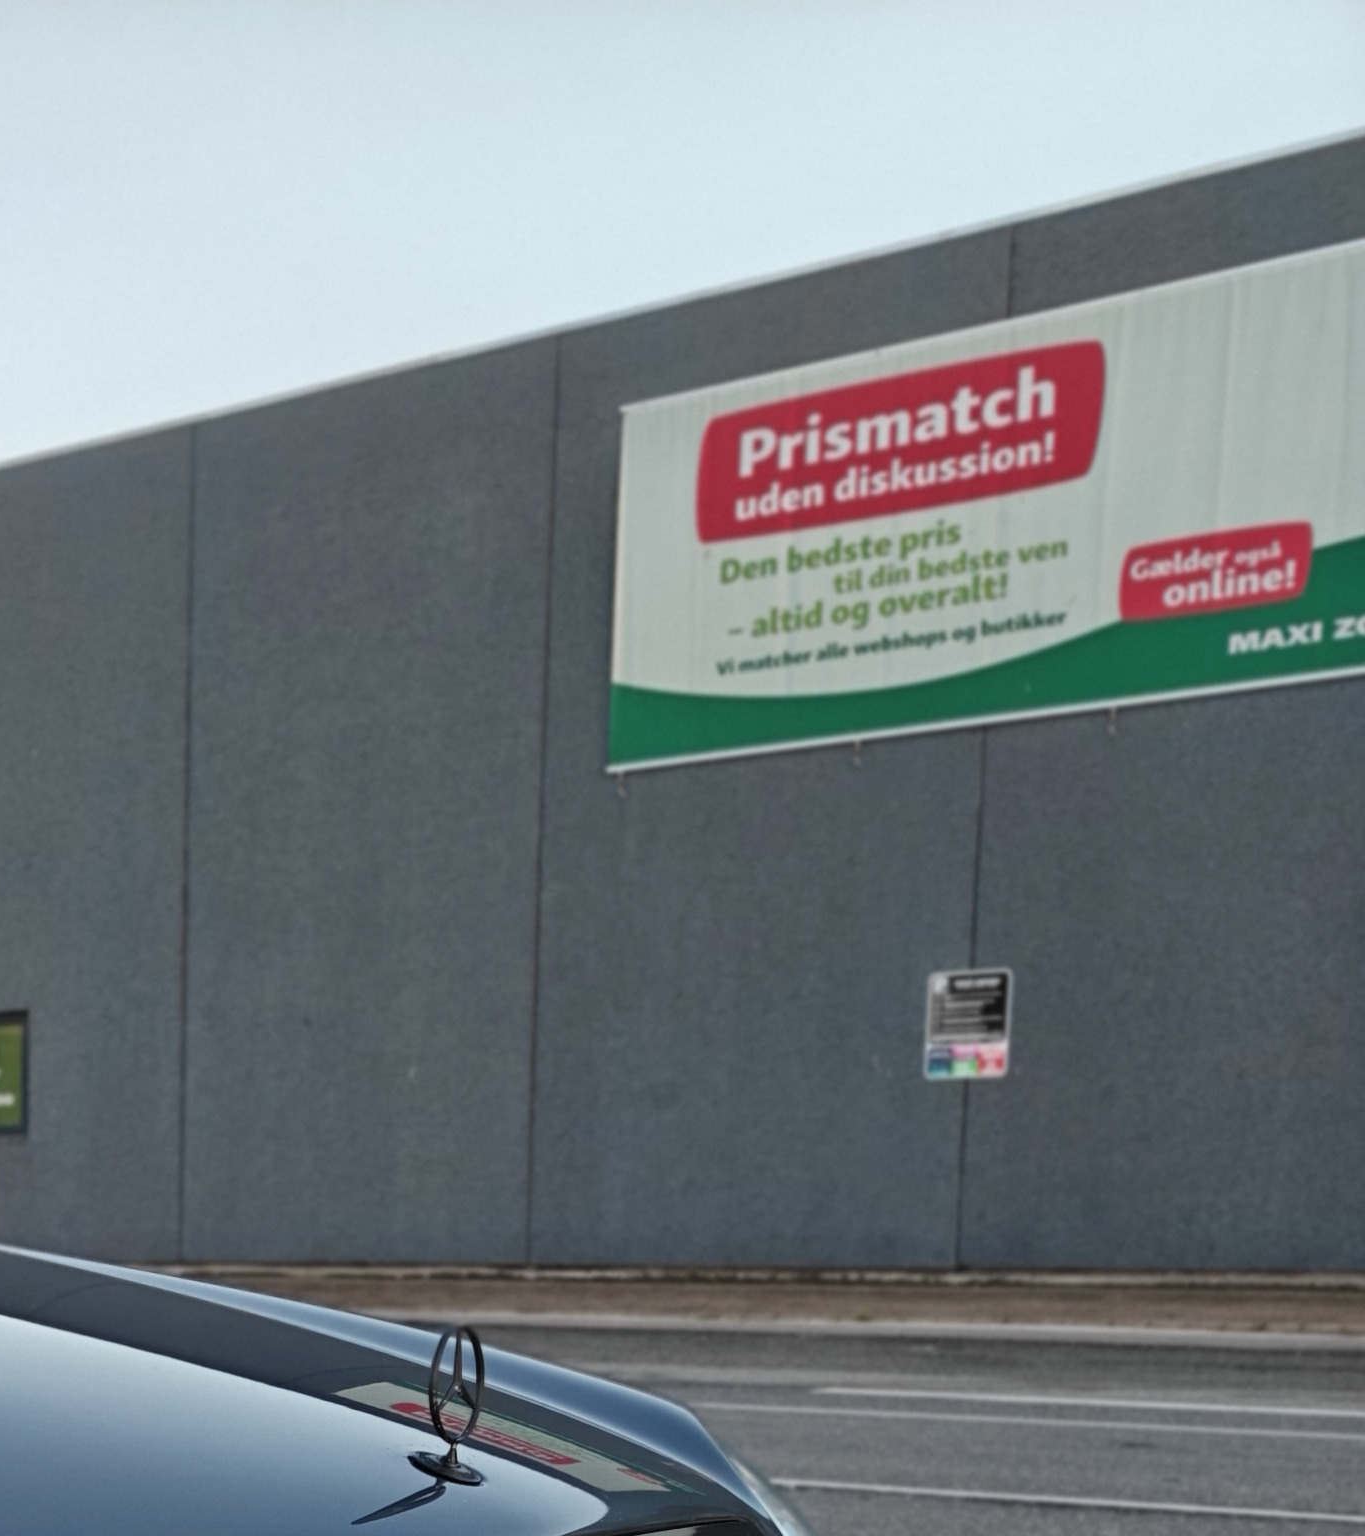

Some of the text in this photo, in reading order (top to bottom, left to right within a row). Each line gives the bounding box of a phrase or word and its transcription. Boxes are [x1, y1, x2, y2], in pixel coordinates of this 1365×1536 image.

[738, 365, 1056, 478] Prismatch
[734, 431, 1055, 521] uden diskussion!
[719, 520, 961, 585] Den bedste pris
[833, 540, 1069, 595] til din bedste ven
[1129, 547, 1230, 581] Gælder
[1162, 559, 1297, 608] online!
[751, 600, 823, 638] altid
[831, 600, 869, 631] og
[878, 572, 1008, 617] overalt!
[1227, 620, 1323, 655] MAXI
[716, 610, 1068, 676] Vi matcher alle webshops og butikker
